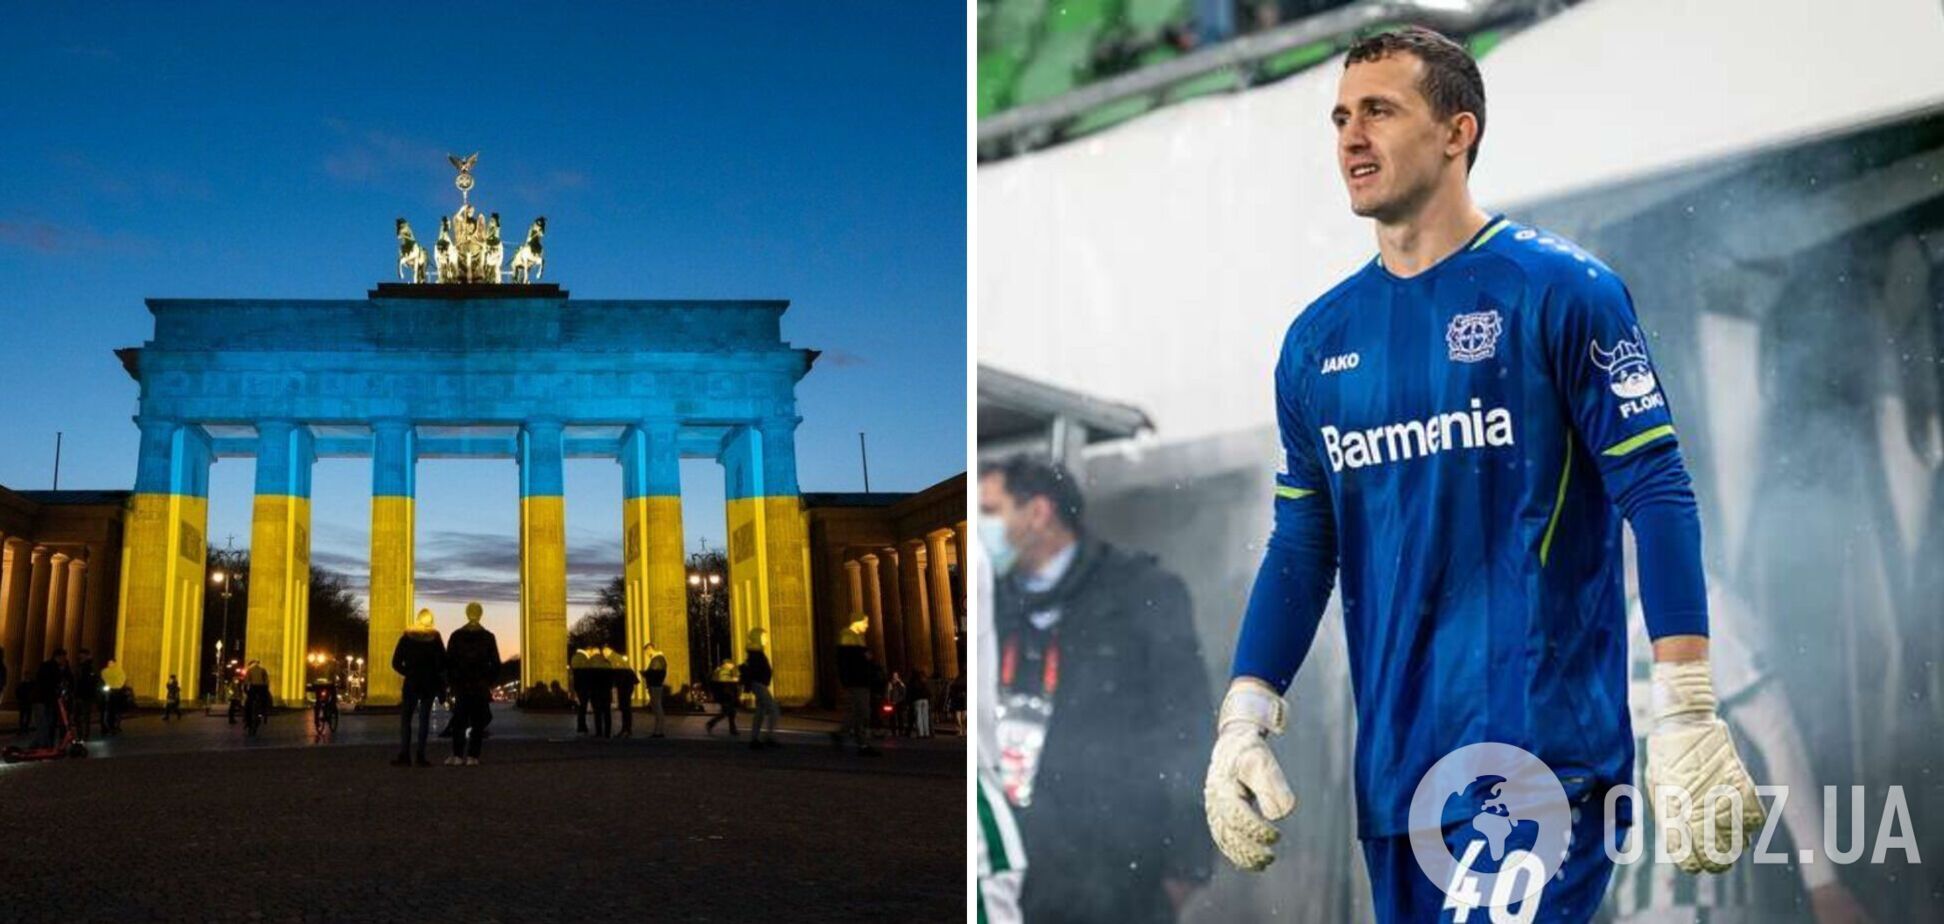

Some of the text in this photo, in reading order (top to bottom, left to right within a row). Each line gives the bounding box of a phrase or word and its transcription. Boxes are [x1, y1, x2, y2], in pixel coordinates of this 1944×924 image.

[1320, 352, 1360, 375] JAKO
[1320, 398, 1514, 473] Barmenia
[1443, 839, 1546, 924] 40
